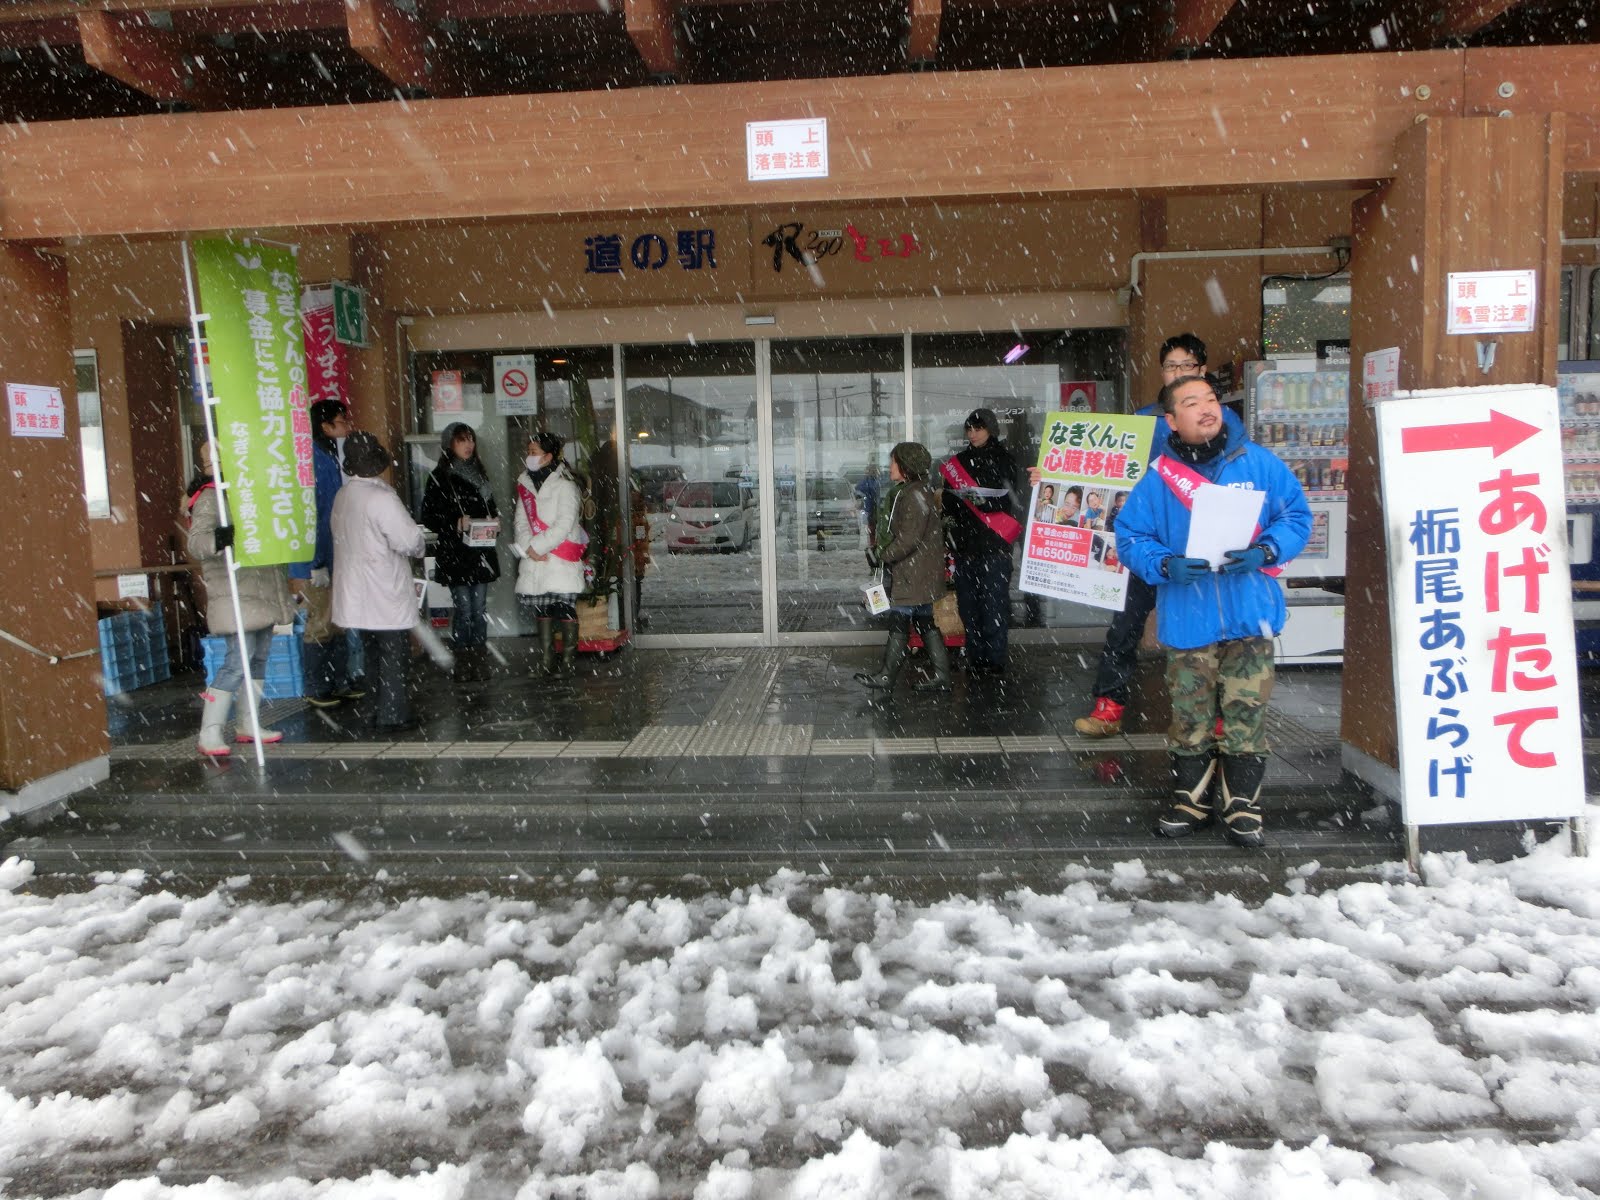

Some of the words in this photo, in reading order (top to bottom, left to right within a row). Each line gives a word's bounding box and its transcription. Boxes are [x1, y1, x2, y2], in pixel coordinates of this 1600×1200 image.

[754, 149, 822, 171] 落雪注意
[584, 229, 718, 274] 道の駅
[1455, 304, 1528, 324] 落雪注意
[14, 412, 61, 430] 落雪注意
[242, 289, 301, 550] 募金にご協力ください。
[1048, 421, 1137, 450] なぎくんに
[1042, 447, 1141, 480] 心臓移植を
[1478, 468, 1559, 769] あげたて
[1408, 507, 1472, 801] 栃尾あぶらげ
